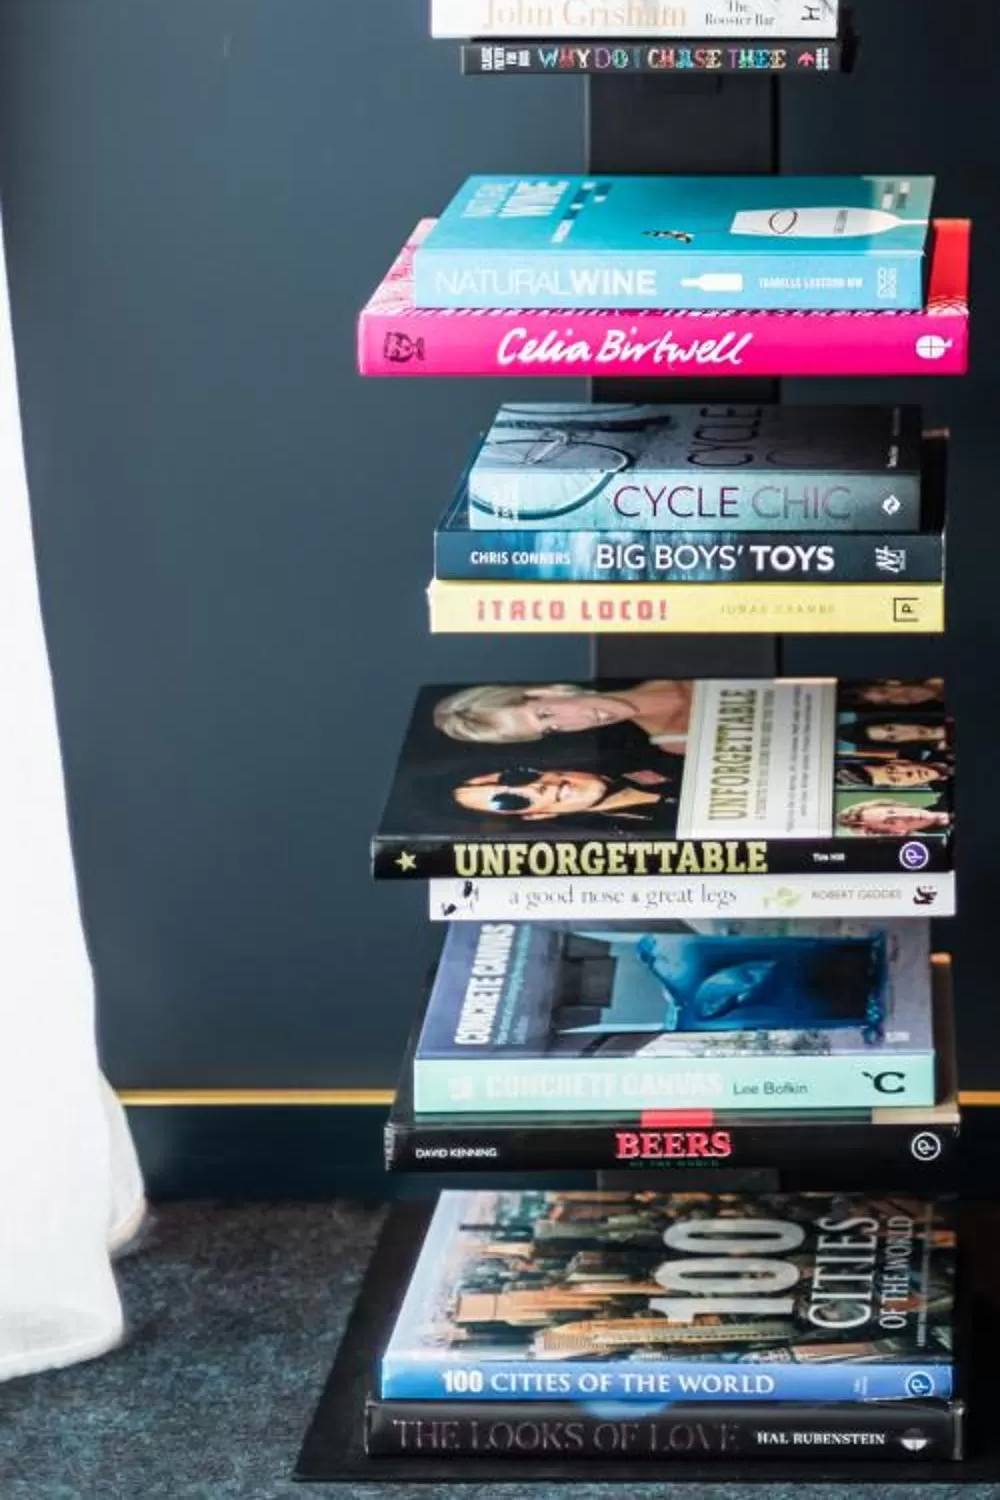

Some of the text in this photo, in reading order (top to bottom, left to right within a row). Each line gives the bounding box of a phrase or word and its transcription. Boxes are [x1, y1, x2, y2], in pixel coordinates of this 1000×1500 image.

[537, 47, 590, 69] WHY
[595, 47, 629, 69] DO
[647, 48, 723, 69] CHASE
[727, 48, 787, 69] THEE
[496, 327, 755, 367] Celia Birtwell
[613, 485, 852, 520] CYCLE CHIC
[470, 551, 509, 565] CHRIS
[597, 544, 645, 570] BIG
[750, 544, 836, 572] TOYS
[706, 688, 759, 822] UNFORGETTABLE
[453, 840, 769, 877] UNFORGETTABLE
[508, 891, 519, 904] a
[525, 884, 574, 910] good
[581, 890, 625, 904] nose
[645, 888, 694, 909] great
[701, 884, 738, 910] legs
[732, 1082, 759, 1096] Lee
[415, 1147, 447, 1158] DAVID
[449, 1147, 498, 1158] KENNING
[614, 1131, 733, 1160] BEERS
[649, 1217, 807, 1322] 100
[807, 1216, 880, 1329] CITIES
[881, 1274, 910, 1302] THE
[442, 1369, 483, 1393] 100
[490, 1372, 572, 1394] CITIES
[578, 1372, 615, 1394] OF
[620, 1372, 671, 1394] THE
[677, 1372, 775, 1395] WORLD
[392, 1419, 886, 1452] THE LOOKS OF LOVE HAL RUBENSTEIN
